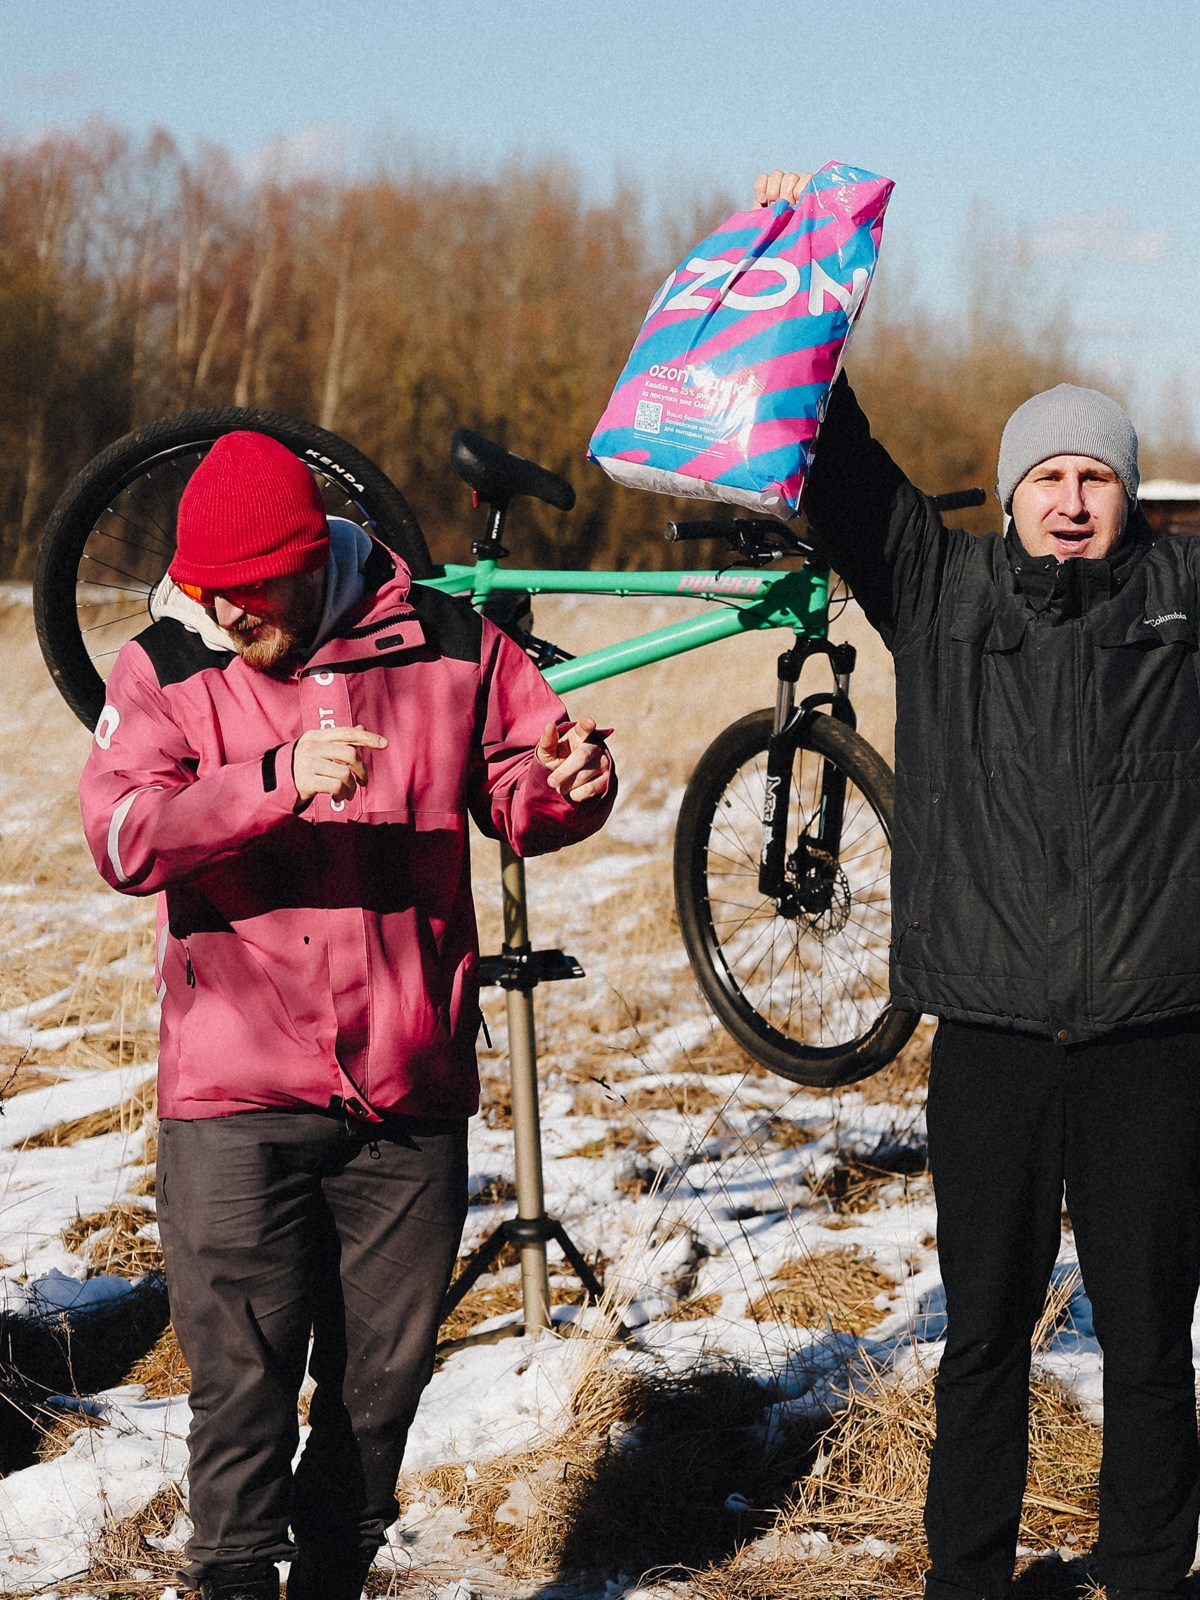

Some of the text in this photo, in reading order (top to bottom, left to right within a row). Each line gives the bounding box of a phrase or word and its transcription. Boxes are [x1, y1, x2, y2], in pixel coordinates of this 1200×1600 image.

[649, 364, 689, 383] ozon
[650, 392, 678, 405] покупки
[679, 398, 693, 407] вне
[680, 386, 696, 397] 25%
[666, 410, 683, 420] Ваша
[664, 426, 675, 434] для
[305, 449, 365, 493] KENDA
[677, 575, 763, 595] PUSHER
[1149, 611, 1187, 628] Columbia
